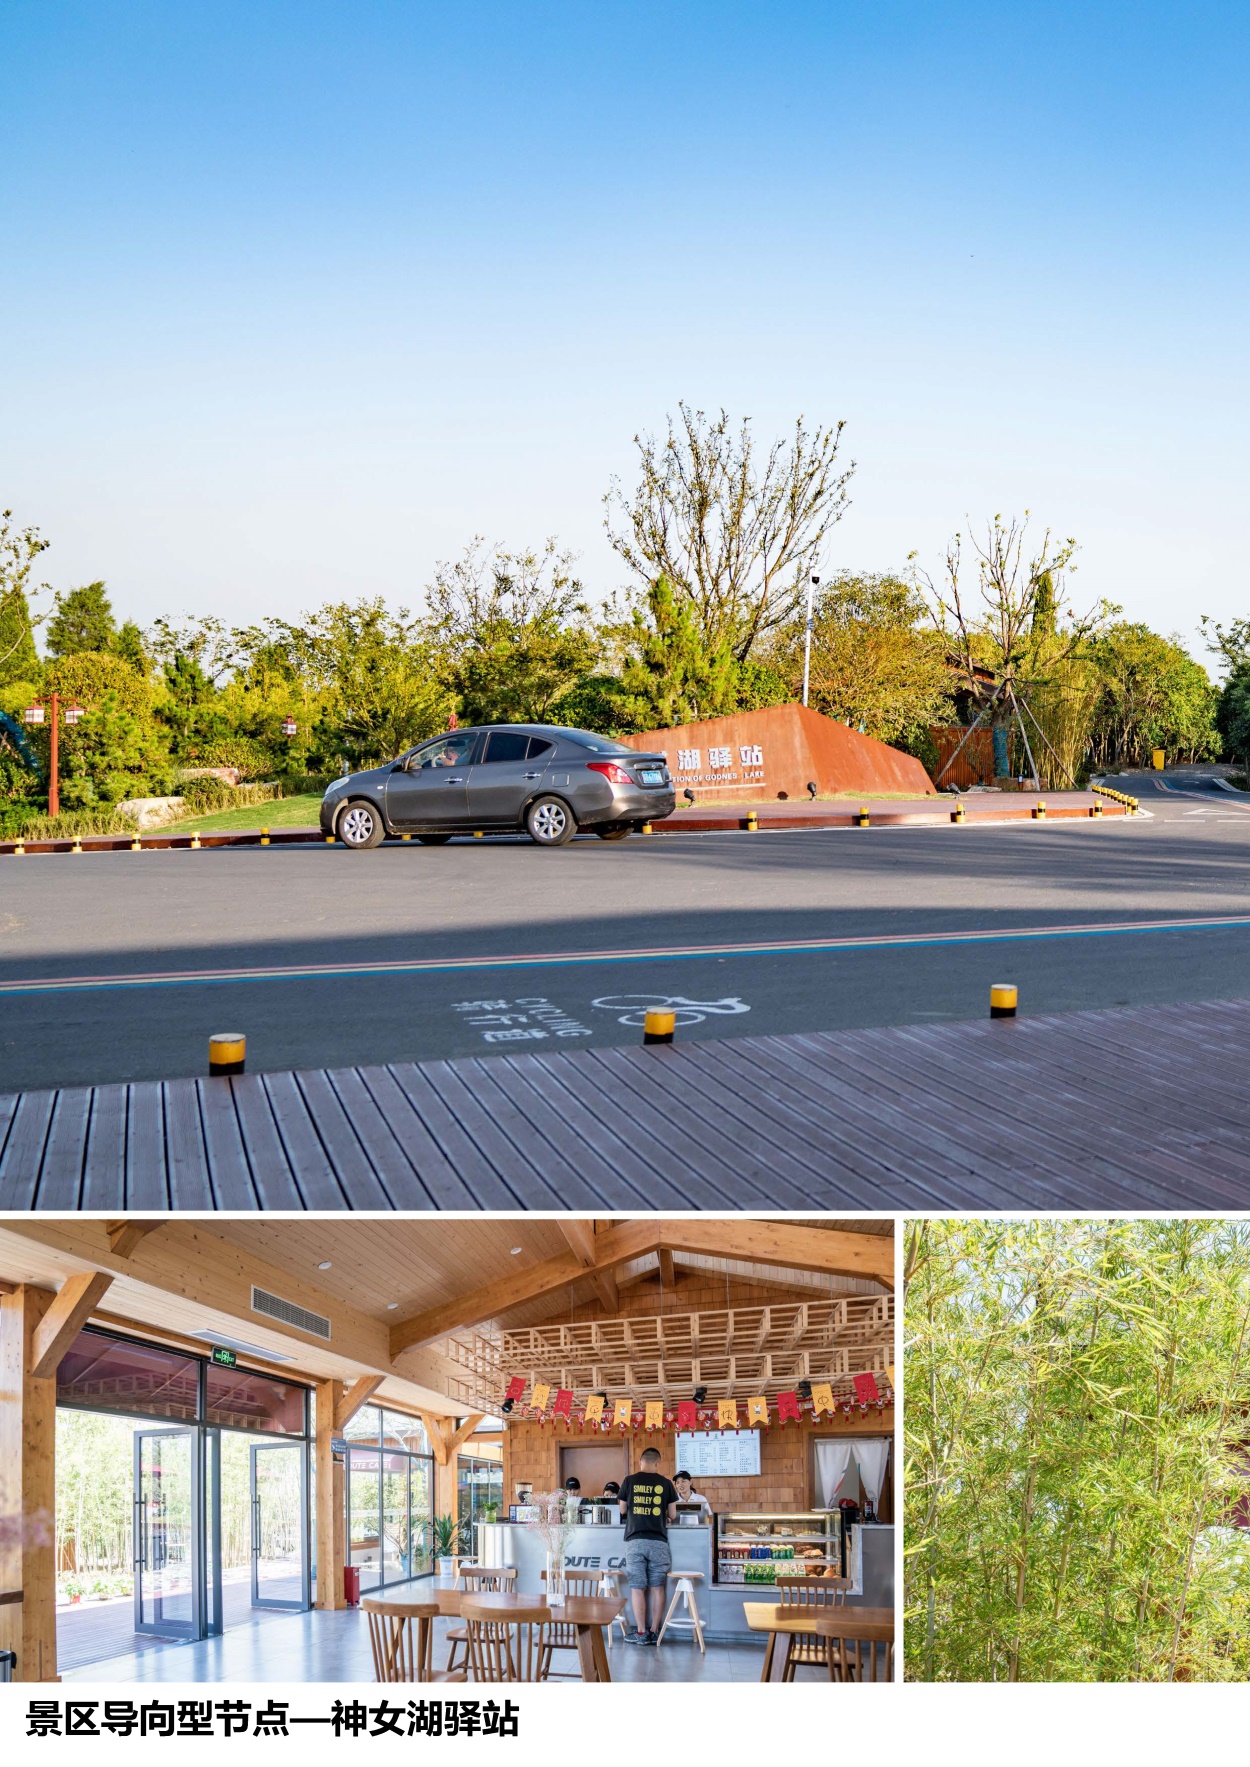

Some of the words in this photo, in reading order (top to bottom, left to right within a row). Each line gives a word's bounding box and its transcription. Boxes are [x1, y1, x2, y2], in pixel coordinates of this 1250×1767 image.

[677, 745, 764, 771] 湖驿站
[669, 773, 691, 783] TION
[515, 997, 593, 1037] CYCLING
[633, 1484, 653, 1494] SMILEY
[633, 1495, 652, 1505] SMILEY
[632, 1506, 651, 1516] SMILEY
[564, 1556, 601, 1568] OUTE
